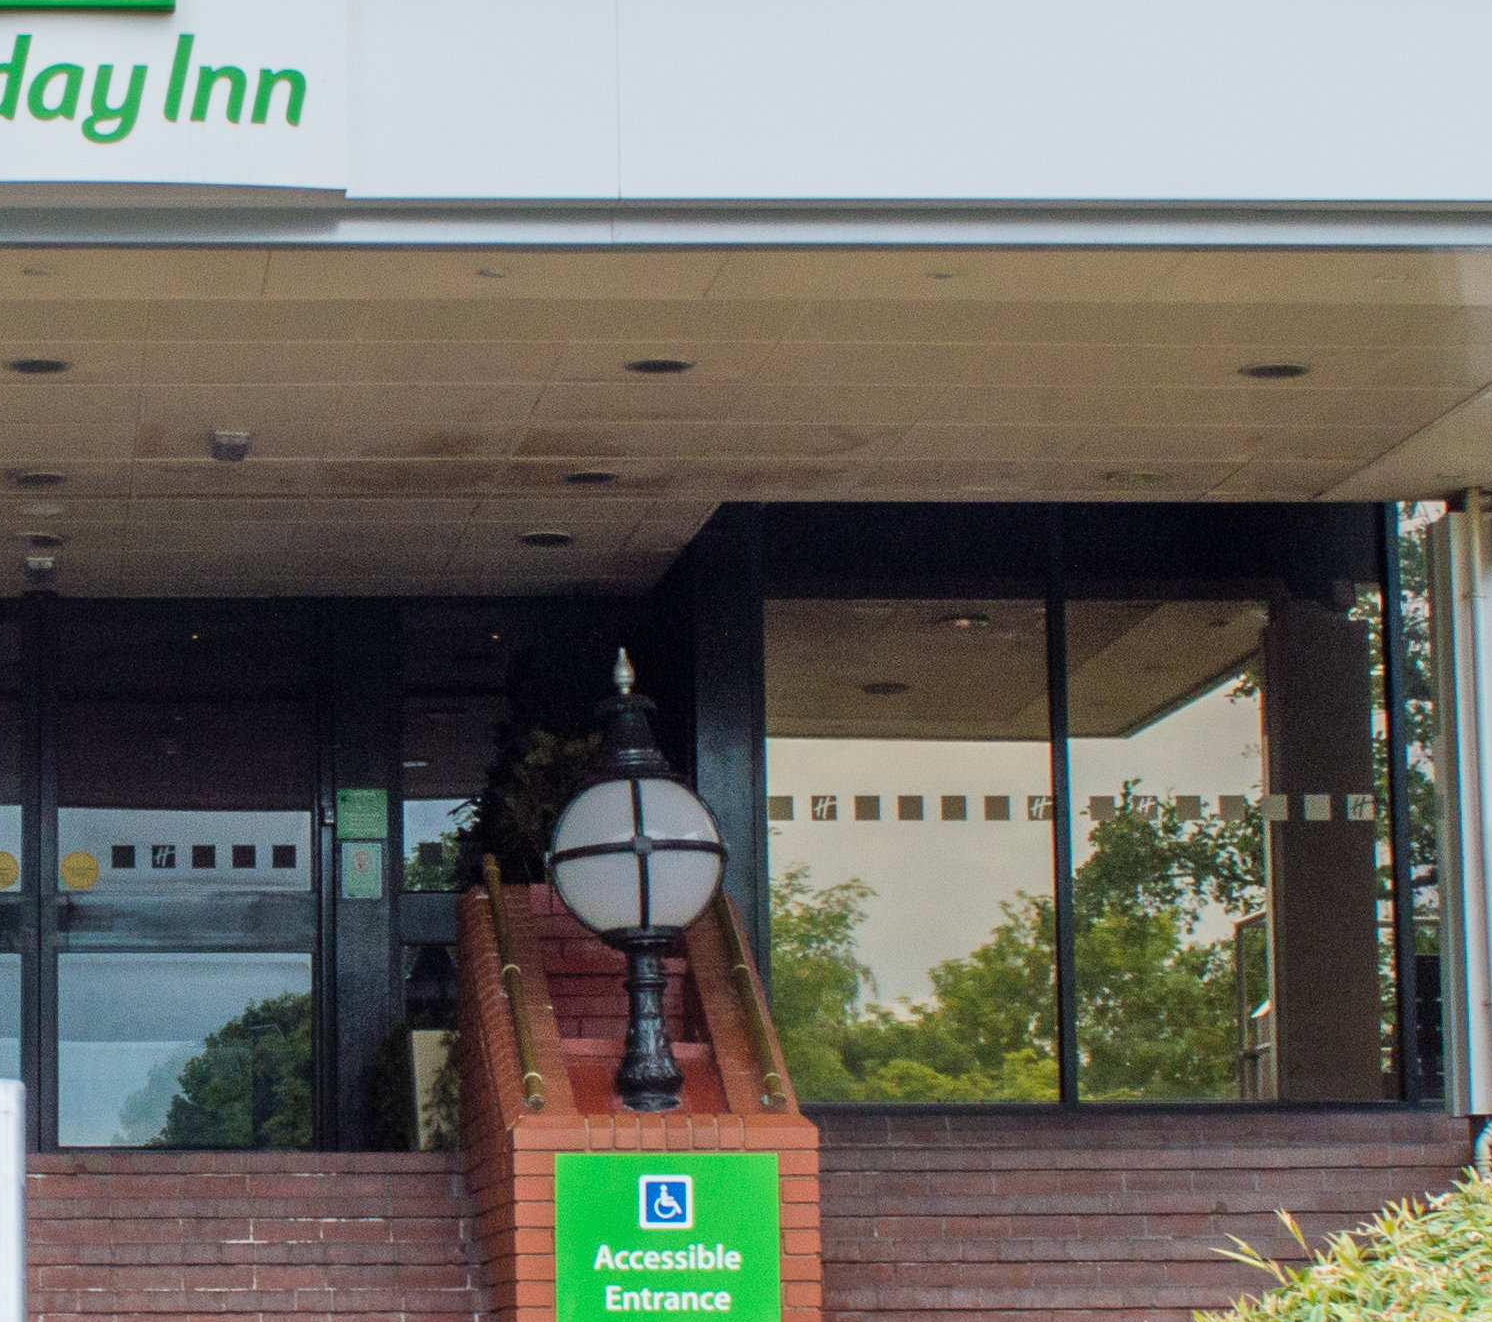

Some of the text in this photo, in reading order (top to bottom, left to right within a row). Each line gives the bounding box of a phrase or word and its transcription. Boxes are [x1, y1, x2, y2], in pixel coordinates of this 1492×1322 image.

[163, 33, 308, 127] Inn
[593, 1244, 742, 1271] Accessible
[604, 1285, 732, 1312] Entrance
